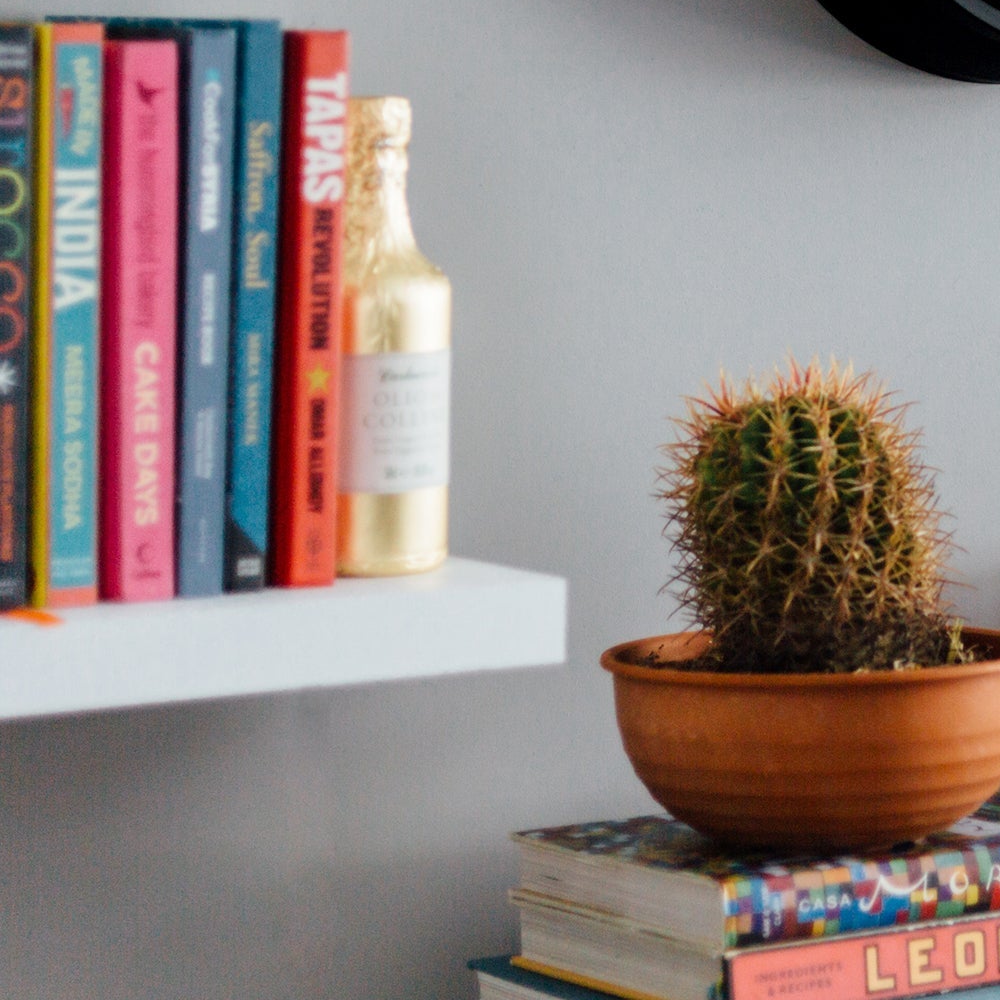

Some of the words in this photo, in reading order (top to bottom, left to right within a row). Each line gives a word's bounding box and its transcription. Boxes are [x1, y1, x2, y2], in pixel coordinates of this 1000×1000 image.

[302, 71, 348, 205] TAPAS
[55, 168, 98, 311] INDIA
[244, 231, 270, 288] Soul
[310, 207, 334, 350] REVOLUTION
[63, 345, 84, 435] MEERA
[134, 341, 160, 434] CAKE
[63, 440, 84, 531] SODHA
[134, 442, 159, 527] DAYS
[799, 893, 851, 914] CASA
[756, 962, 843, 981] INGREDIENTS
[780, 979, 832, 994] RECIPES
